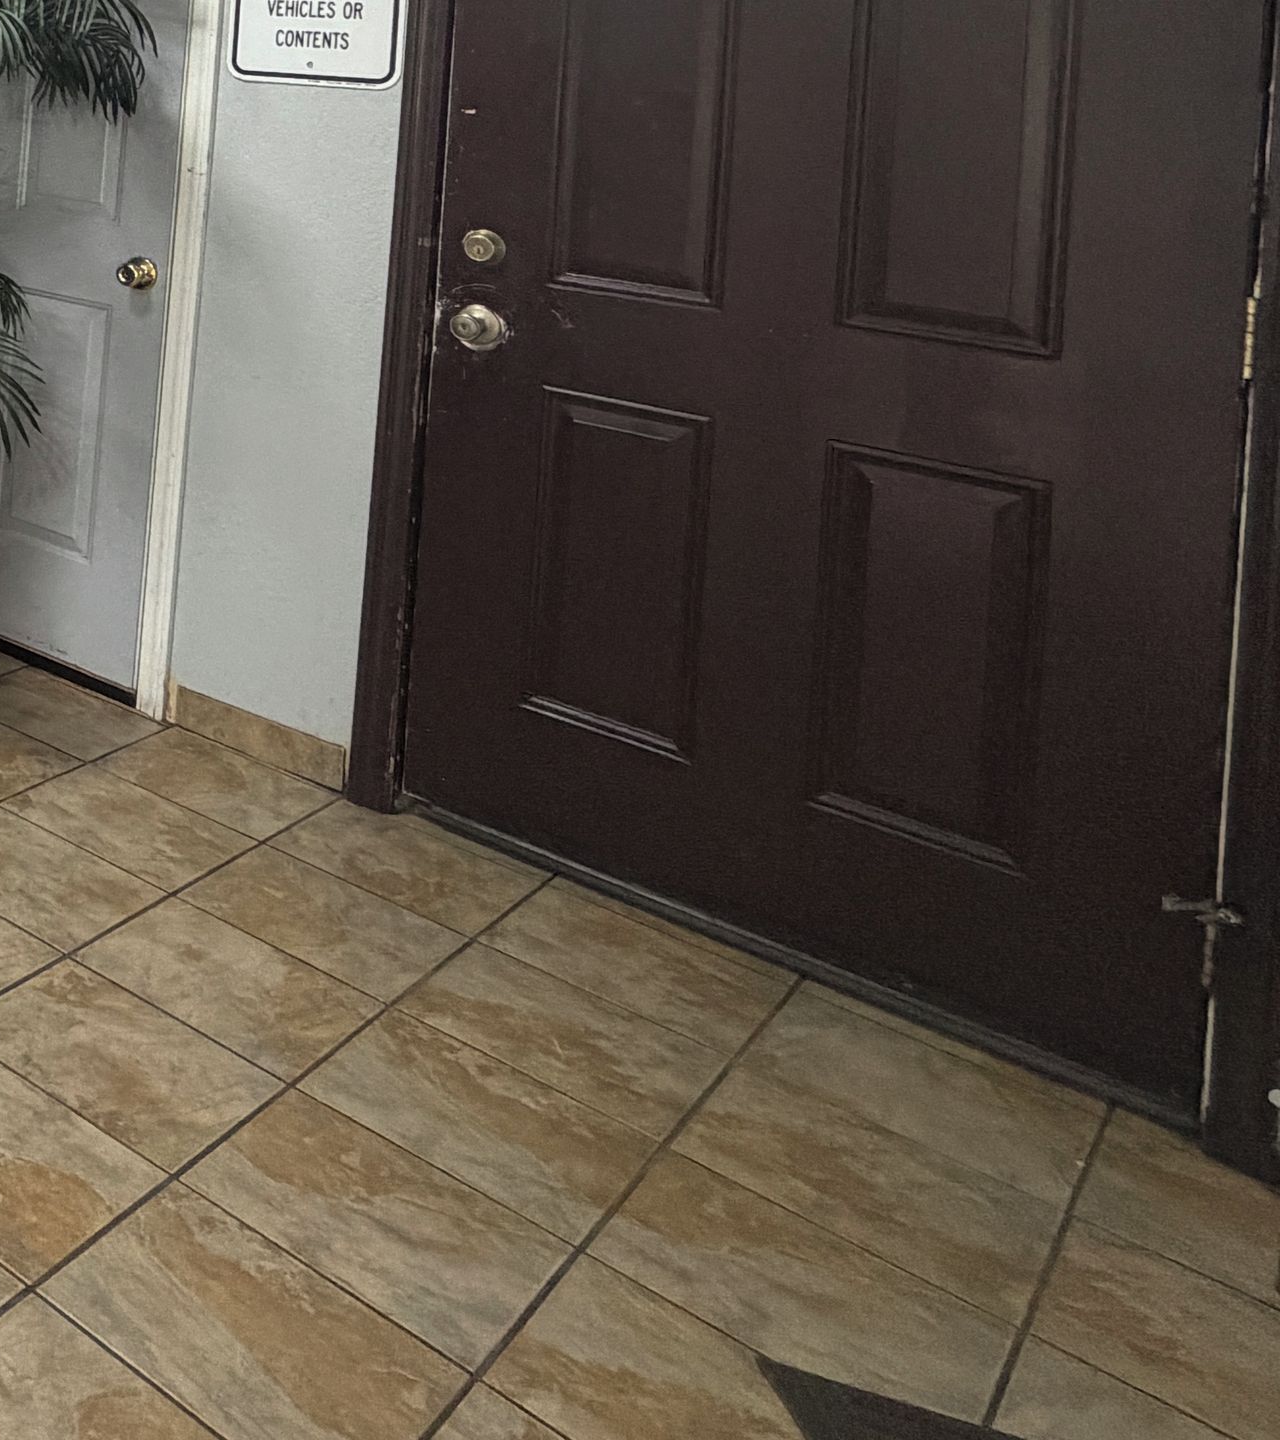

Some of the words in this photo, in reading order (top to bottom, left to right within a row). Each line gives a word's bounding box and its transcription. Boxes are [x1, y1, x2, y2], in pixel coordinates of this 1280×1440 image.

[267, 0, 336, 19] VEHICLES
[343, 2, 364, 20] OR
[275, 29, 350, 50] CONTENTS
